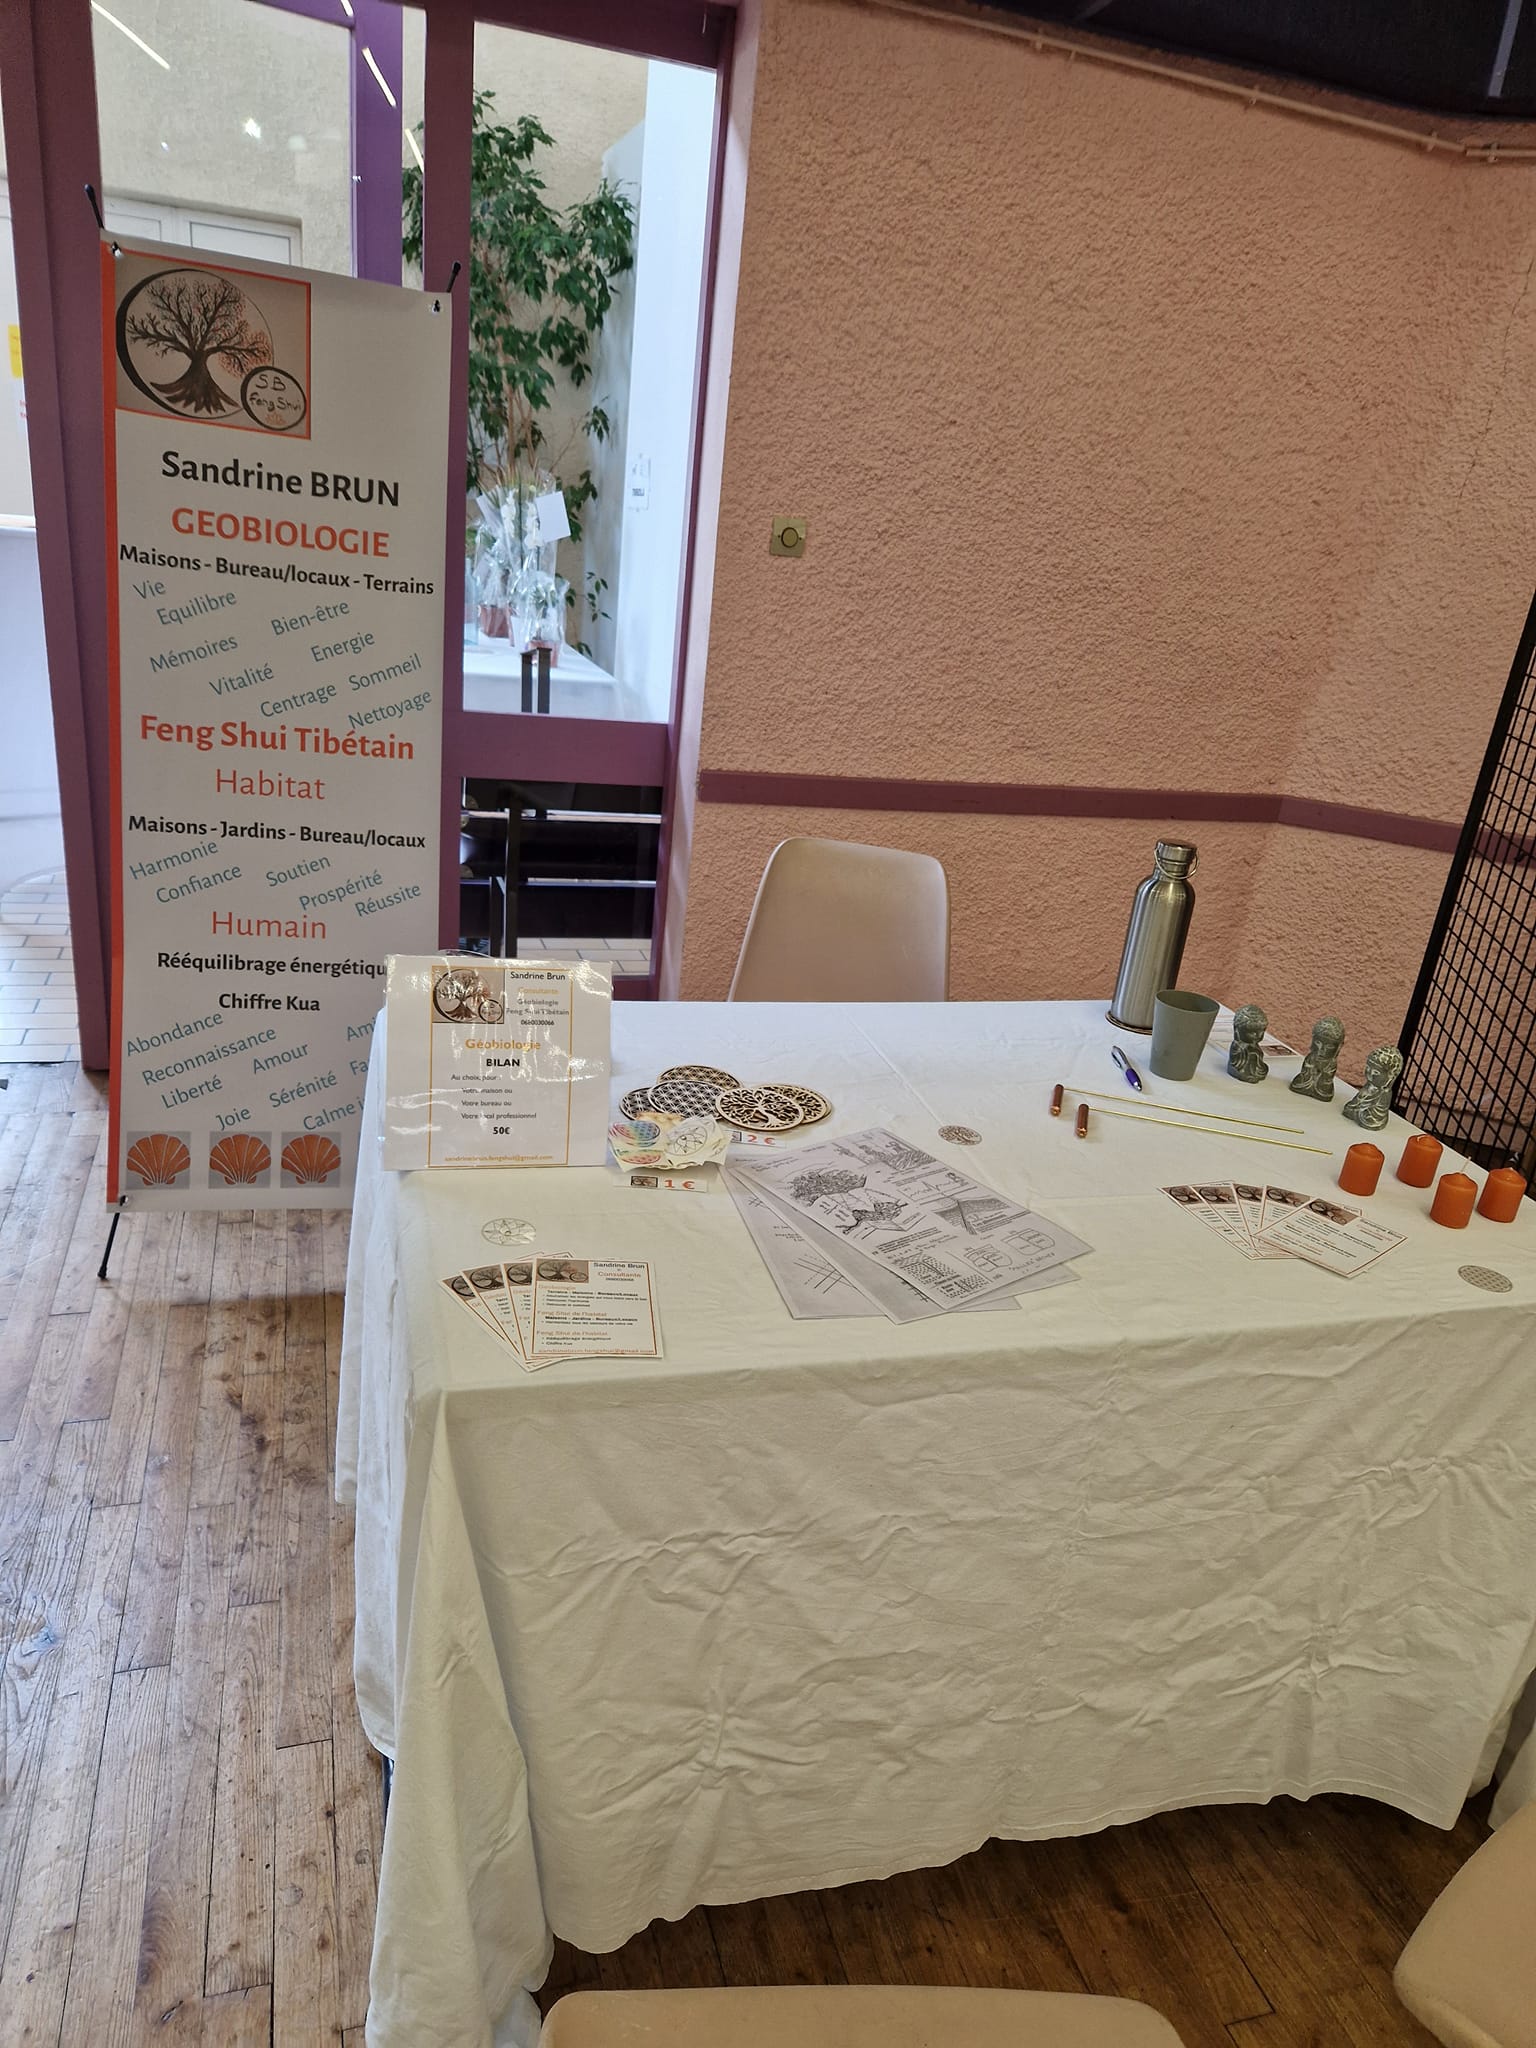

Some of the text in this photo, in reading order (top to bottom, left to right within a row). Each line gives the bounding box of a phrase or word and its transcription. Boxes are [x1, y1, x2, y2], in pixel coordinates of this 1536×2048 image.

[162, 451, 400, 506] Sandrine BRUN
[172, 508, 390, 557] GEOBIOLOGIE
[120, 544, 200, 571] Maisons
[216, 558, 349, 588] Bureau/locaux
[363, 574, 434, 595] Terrains
[133, 580, 166, 600] Vie
[156, 590, 237, 626] Equilibre
[271, 601, 350, 636] Bien-être
[149, 636, 238, 673] Mémoires
[310, 632, 375, 663] Energie
[209, 663, 274, 697] Vitalité
[348, 653, 423, 691] Sommeil
[260, 683, 337, 718] Centrage
[348, 689, 433, 729] Nettoyage
[140, 715, 415, 760] Feng Shui Tibétain
[215, 768, 326, 800] Habitat
[128, 815, 207, 836] Maisons
[219, 821, 287, 841] Jardins
[299, 826, 426, 849] Bureau/locaux
[129, 839, 219, 880] Harmonie
[266, 855, 331, 887] Soutien
[156, 864, 242, 904] Confiance
[299, 870, 383, 911] Prospérité
[354, 883, 422, 917] Réussite
[212, 911, 327, 939] Humain
[157, 952, 387, 979] Rééquilibrage énergétiqu
[510, 971, 566, 981] Sandrine Brun
[218, 993, 320, 1012] Chiffre Kua
[506, 1007, 523, 1015] Feng
[126, 1011, 223, 1056] Abondance
[465, 1038, 541, 1052] Géobiologie
[142, 1027, 277, 1086] Reconnaissance
[252, 1042, 310, 1074] Amour
[486, 1058, 520, 1067] BILAN
[161, 1075, 223, 1109] Liberté
[269, 1071, 338, 1108] Sérénité
[215, 1106, 251, 1131] Joie
[303, 1103, 356, 1131] Calme
[493, 1126, 511, 1135] 50€
[747, 1134, 758, 1143] 2
[664, 1180, 675, 1189] 1
